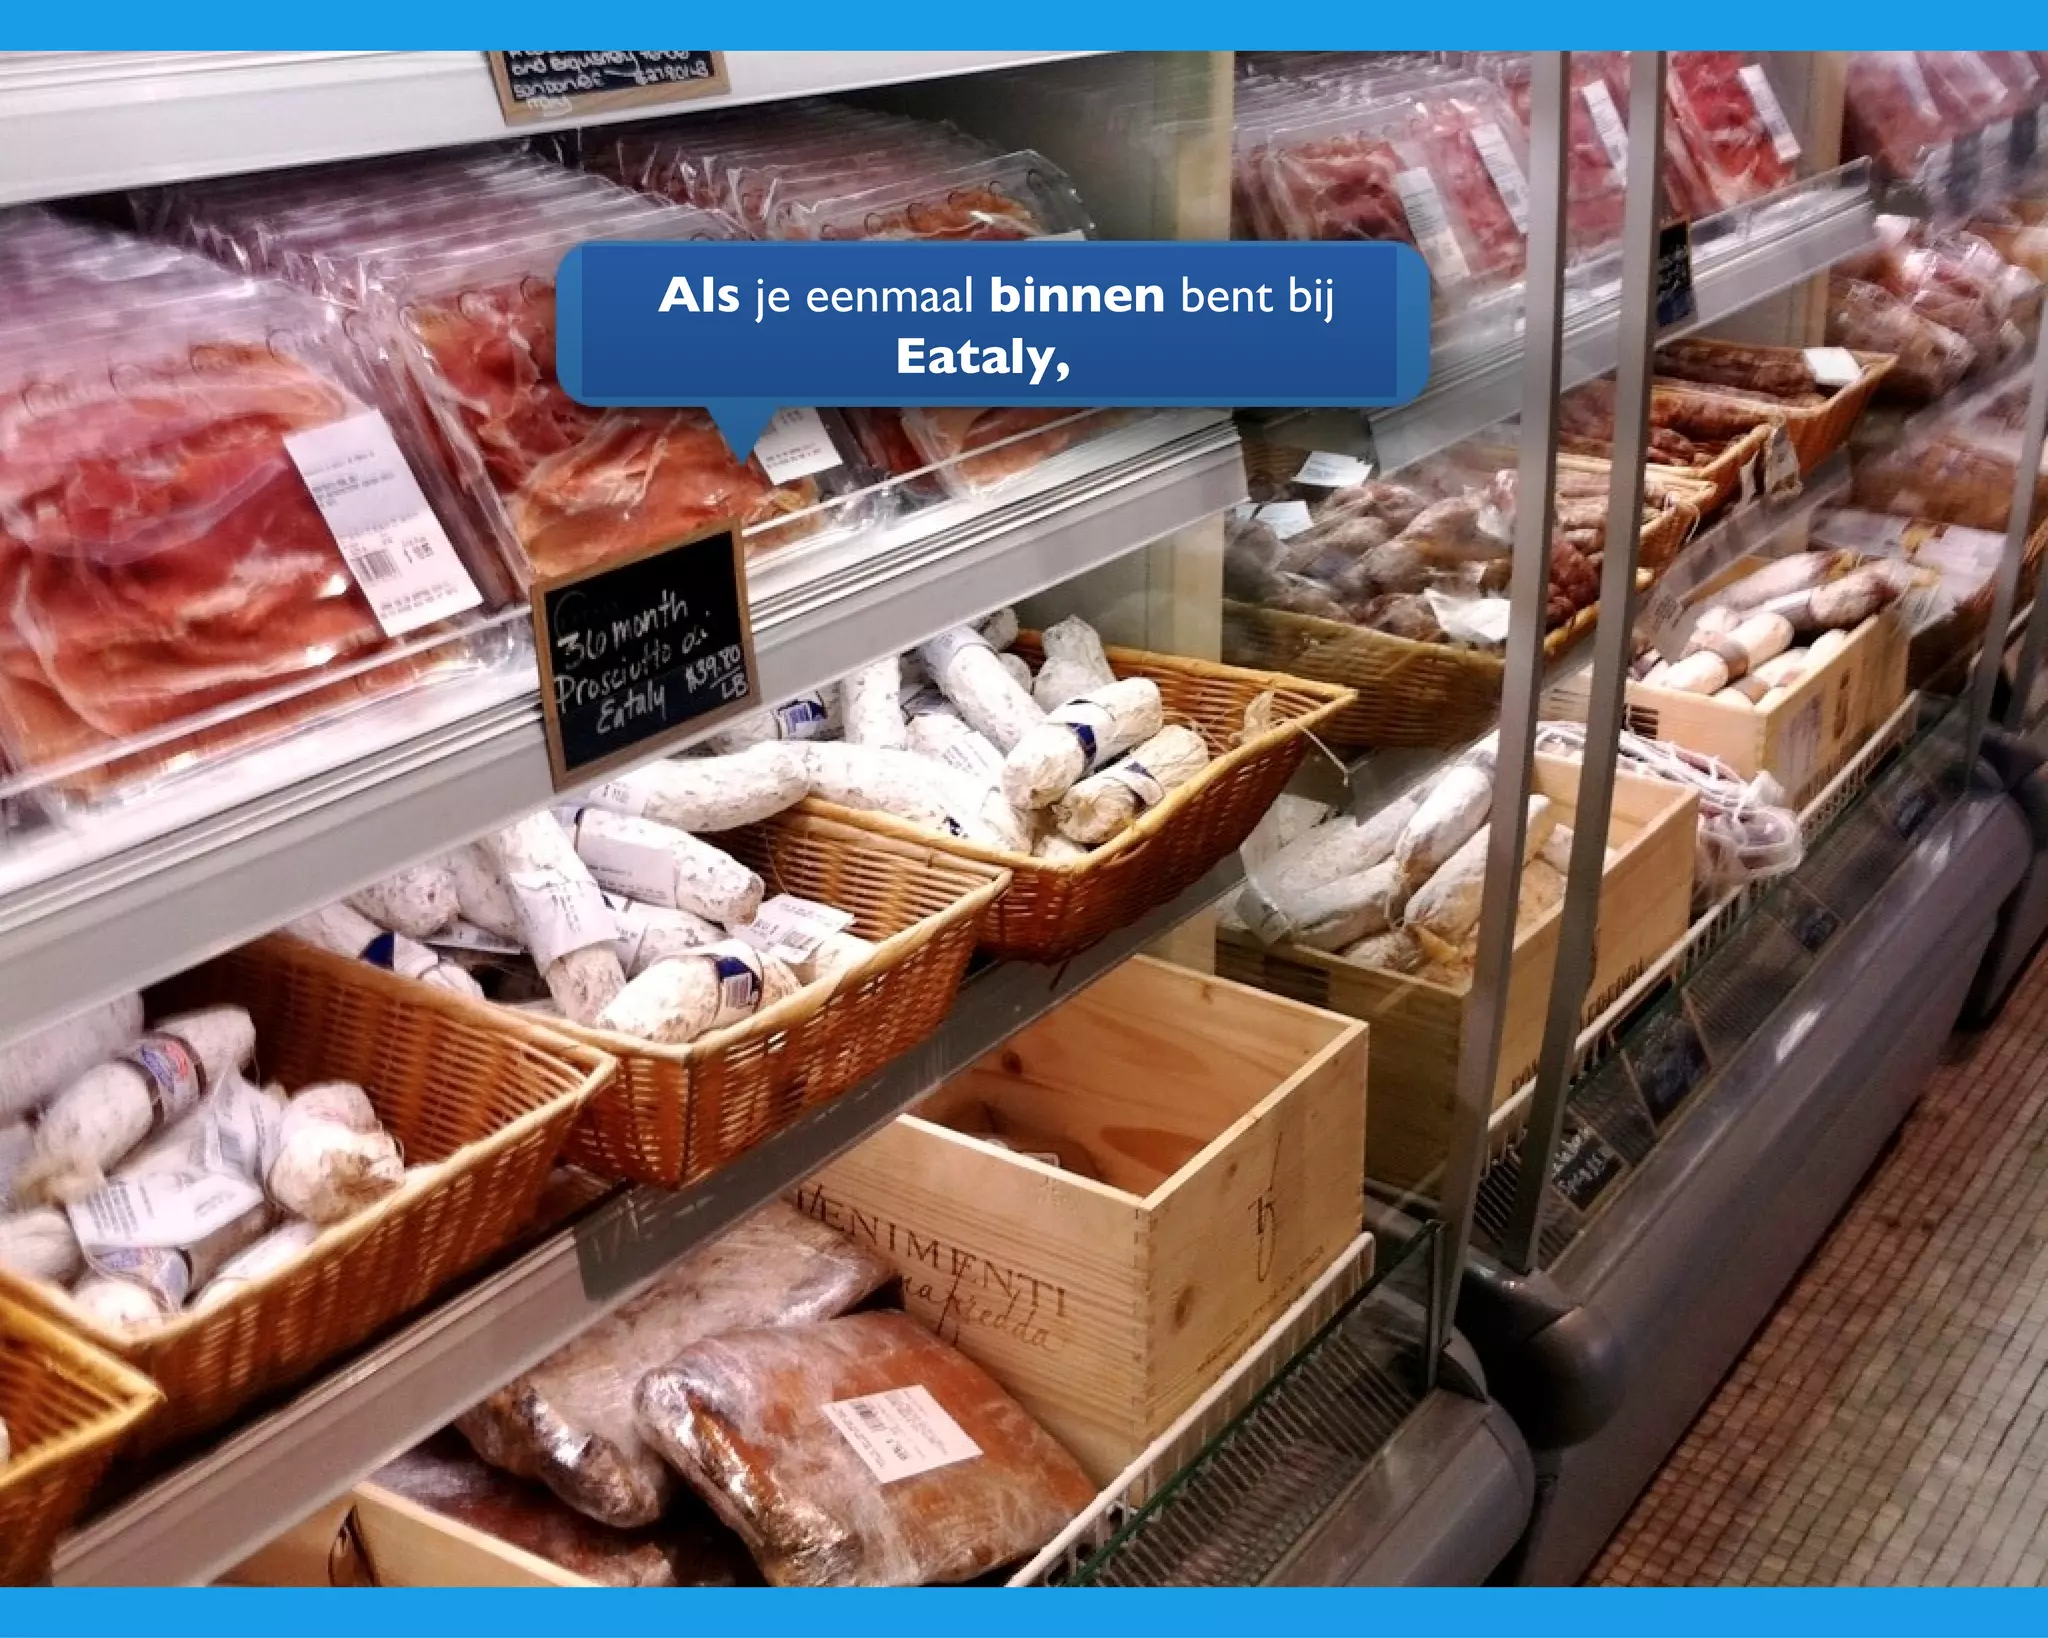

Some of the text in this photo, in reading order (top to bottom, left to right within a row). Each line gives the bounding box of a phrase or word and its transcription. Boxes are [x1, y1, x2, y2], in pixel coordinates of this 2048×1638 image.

[557, 589, 688, 671] 36 month
[597, 679, 666, 734] Eataly
[721, 674, 748, 700] LB
